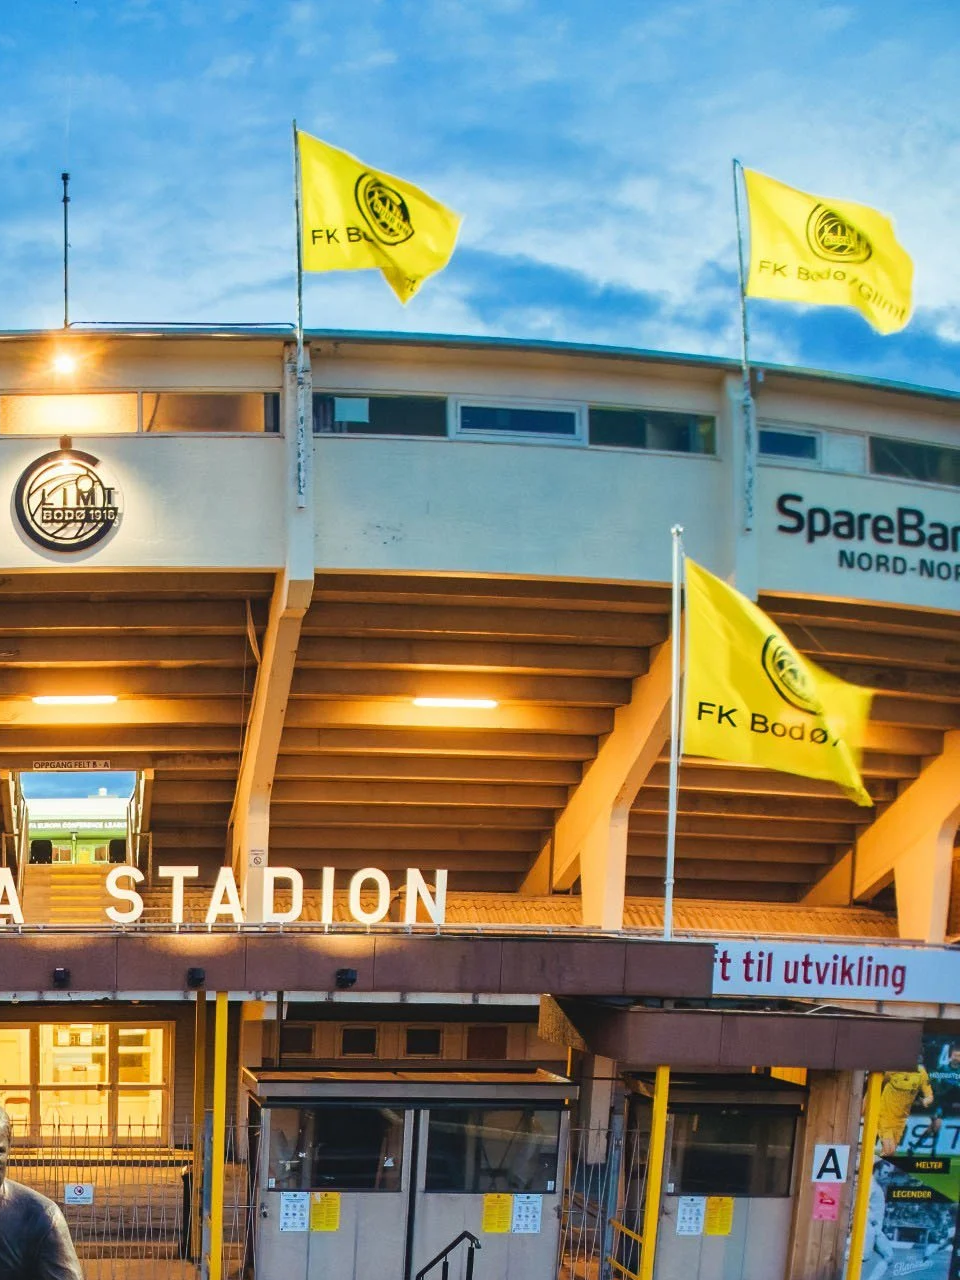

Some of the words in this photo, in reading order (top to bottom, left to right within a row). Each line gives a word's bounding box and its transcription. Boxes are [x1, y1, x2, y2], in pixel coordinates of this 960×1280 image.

[311, 229, 340, 245] FK
[758, 260, 788, 277] FK
[42, 509, 86, 521] BODØ
[89, 509, 115, 521] 1916
[697, 701, 737, 727] FK
[33, 761, 73, 769] OPPGANG
[74, 761, 90, 769] FELT
[105, 865, 448, 925] STADION
[713, 950, 733, 982] t
[742, 950, 773, 983] til
[783, 953, 907, 995] utvikling
[816, 1148, 842, 1179] A
[915, 1161, 943, 1169] HELTER
[892, 1190, 932, 1199] LEGENDER
